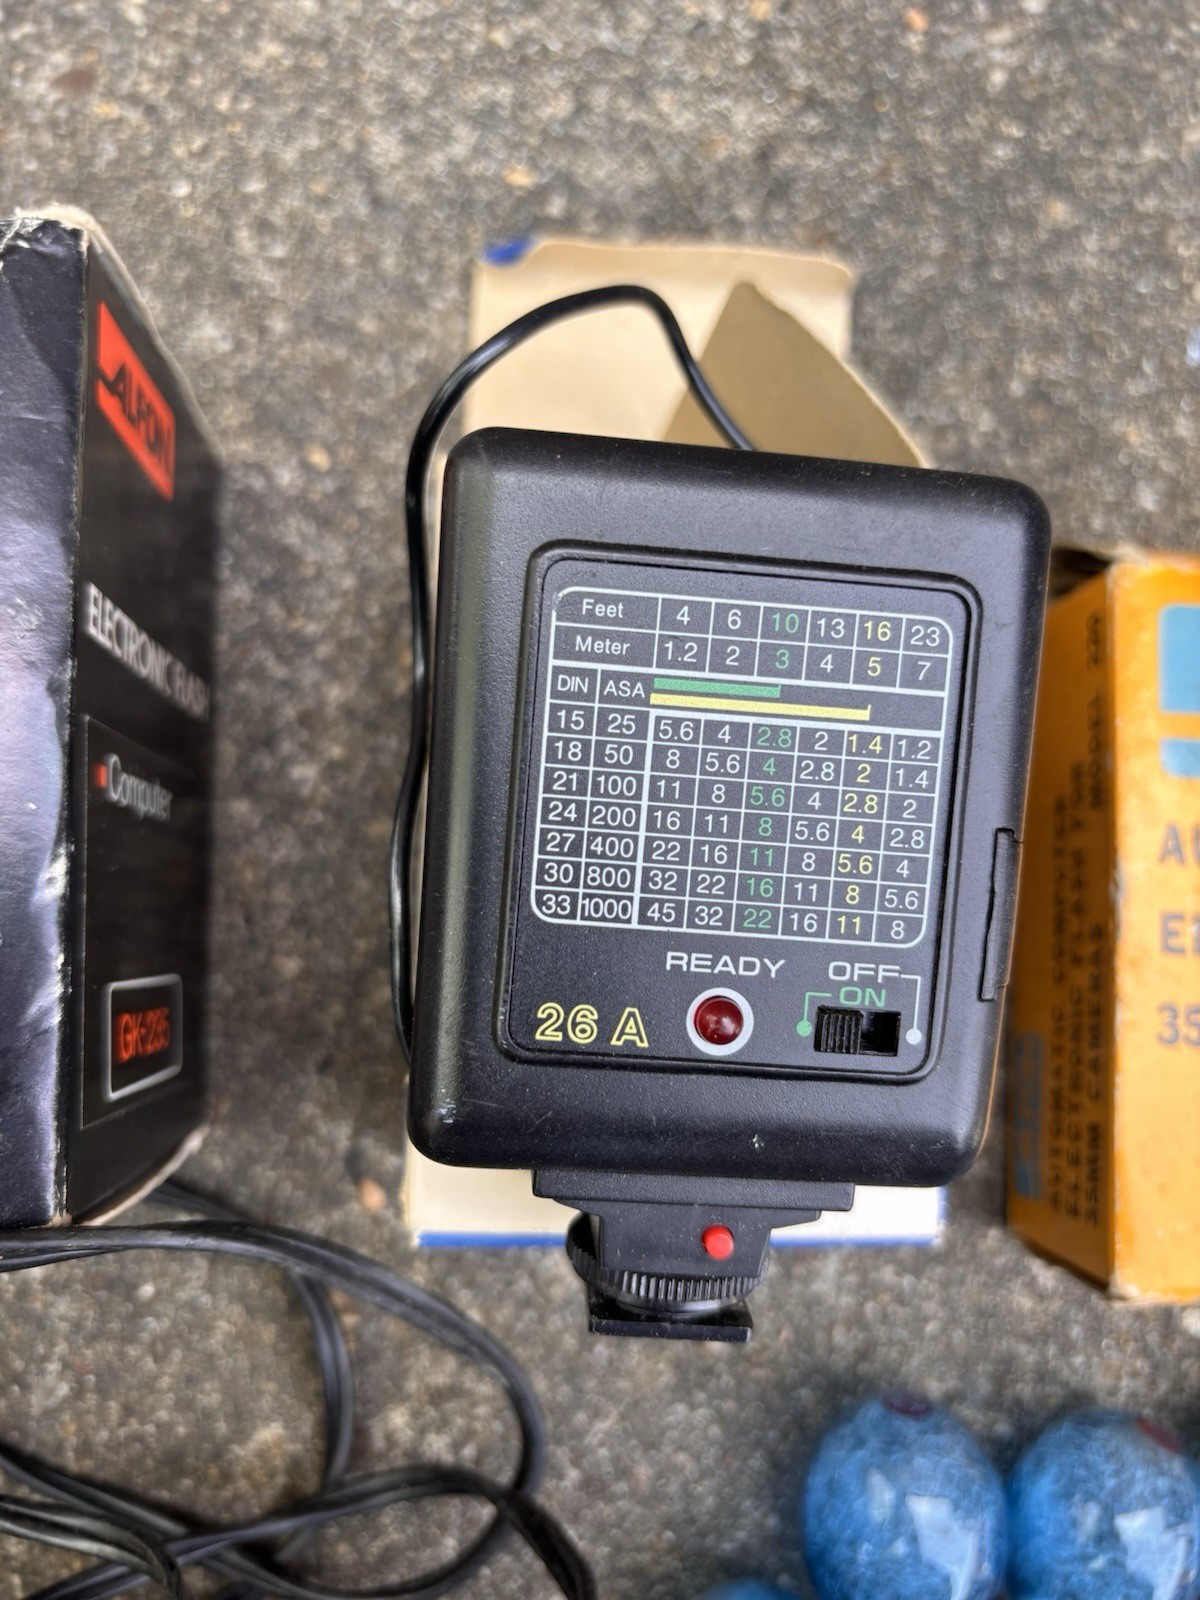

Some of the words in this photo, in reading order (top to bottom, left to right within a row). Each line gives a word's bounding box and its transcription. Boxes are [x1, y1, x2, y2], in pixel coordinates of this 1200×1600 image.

[582, 598, 624, 618] Feet
[676, 605, 690, 625] 4
[728, 609, 741, 630] 6
[772, 613, 799, 633] 10
[817, 618, 845, 638] 13
[864, 621, 891, 641] 16
[910, 625, 940, 647] 23
[86, 581, 173, 697] ELECTRONIC
[174, 656, 210, 722] FLASH
[575, 635, 630, 655] Meter
[664, 641, 698, 662] 1.2
[725, 645, 740, 666] 2
[775, 649, 789, 669] 3
[820, 654, 833, 673] 4
[867, 657, 881, 676] 5
[918, 661, 931, 680] 7
[557, 674, 589, 693] DIN
[603, 680, 645, 698] ASA
[557, 709, 584, 730] 15
[607, 713, 636, 735] 25
[659, 719, 693, 741] 5.6
[718, 724, 731, 743] 4
[757, 727, 791, 748] 2.8
[814, 731, 828, 751] 2
[849, 734, 882, 754] 1.4
[898, 739, 931, 760] 1.2
[107, 753, 173, 820] Computer
[554, 740, 582, 761] 18
[604, 744, 633, 765] 50
[666, 749, 680, 769] 8
[705, 752, 740, 774] 5.6
[763, 757, 776, 776] 4
[800, 760, 835, 781] 2.8
[856, 763, 871, 783] 2
[895, 768, 929, 789] 1.4
[552, 771, 577, 791] 21
[597, 775, 637, 796] 100
[657, 779, 680, 799] 11
[712, 784, 725, 804] 8
[750, 786, 785, 807] 5.6
[807, 791, 821, 810] 4
[843, 793, 878, 814] 2.8
[902, 799, 917, 819] 2
[548, 801, 577, 822] 24
[592, 805, 636, 827] 200
[654, 810, 680, 830] 16
[704, 814, 728, 833] 11
[758, 817, 772, 836] 8
[795, 821, 830, 842] 5.6
[851, 825, 865, 844] 4
[890, 828, 924, 849] 2.8
[546, 832, 576, 852] 27
[590, 836, 634, 858] 400
[652, 840, 681, 861] 22
[701, 844, 728, 864] 16
[751, 848, 772, 867] 11
[802, 852, 816, 872] 8
[838, 853, 872, 874] 5.6
[896, 859, 910, 878] 4
[544, 862, 574, 884] 30
[587, 866, 631, 888] 800
[649, 870, 678, 891] 32
[696, 874, 725, 895] 22
[747, 878, 773, 897] 16
[794, 882, 817, 902] 11
[846, 885, 859, 905] 8
[884, 889, 919, 910] 5.6
[542, 894, 571, 915] 33
[581, 897, 632, 920] 1000
[647, 902, 675, 923] 45
[694, 905, 723, 926] 32
[743, 908, 772, 928] 22
[790, 912, 818, 933] 16
[837, 915, 860, 935] 11
[890, 920, 905, 940] 8
[666, 951, 785, 978] READY
[828, 961, 900, 983] OFF
[838, 986, 887, 1007] ON
[535, 1002, 598, 1044] 26
[610, 1007, 649, 1048] A
